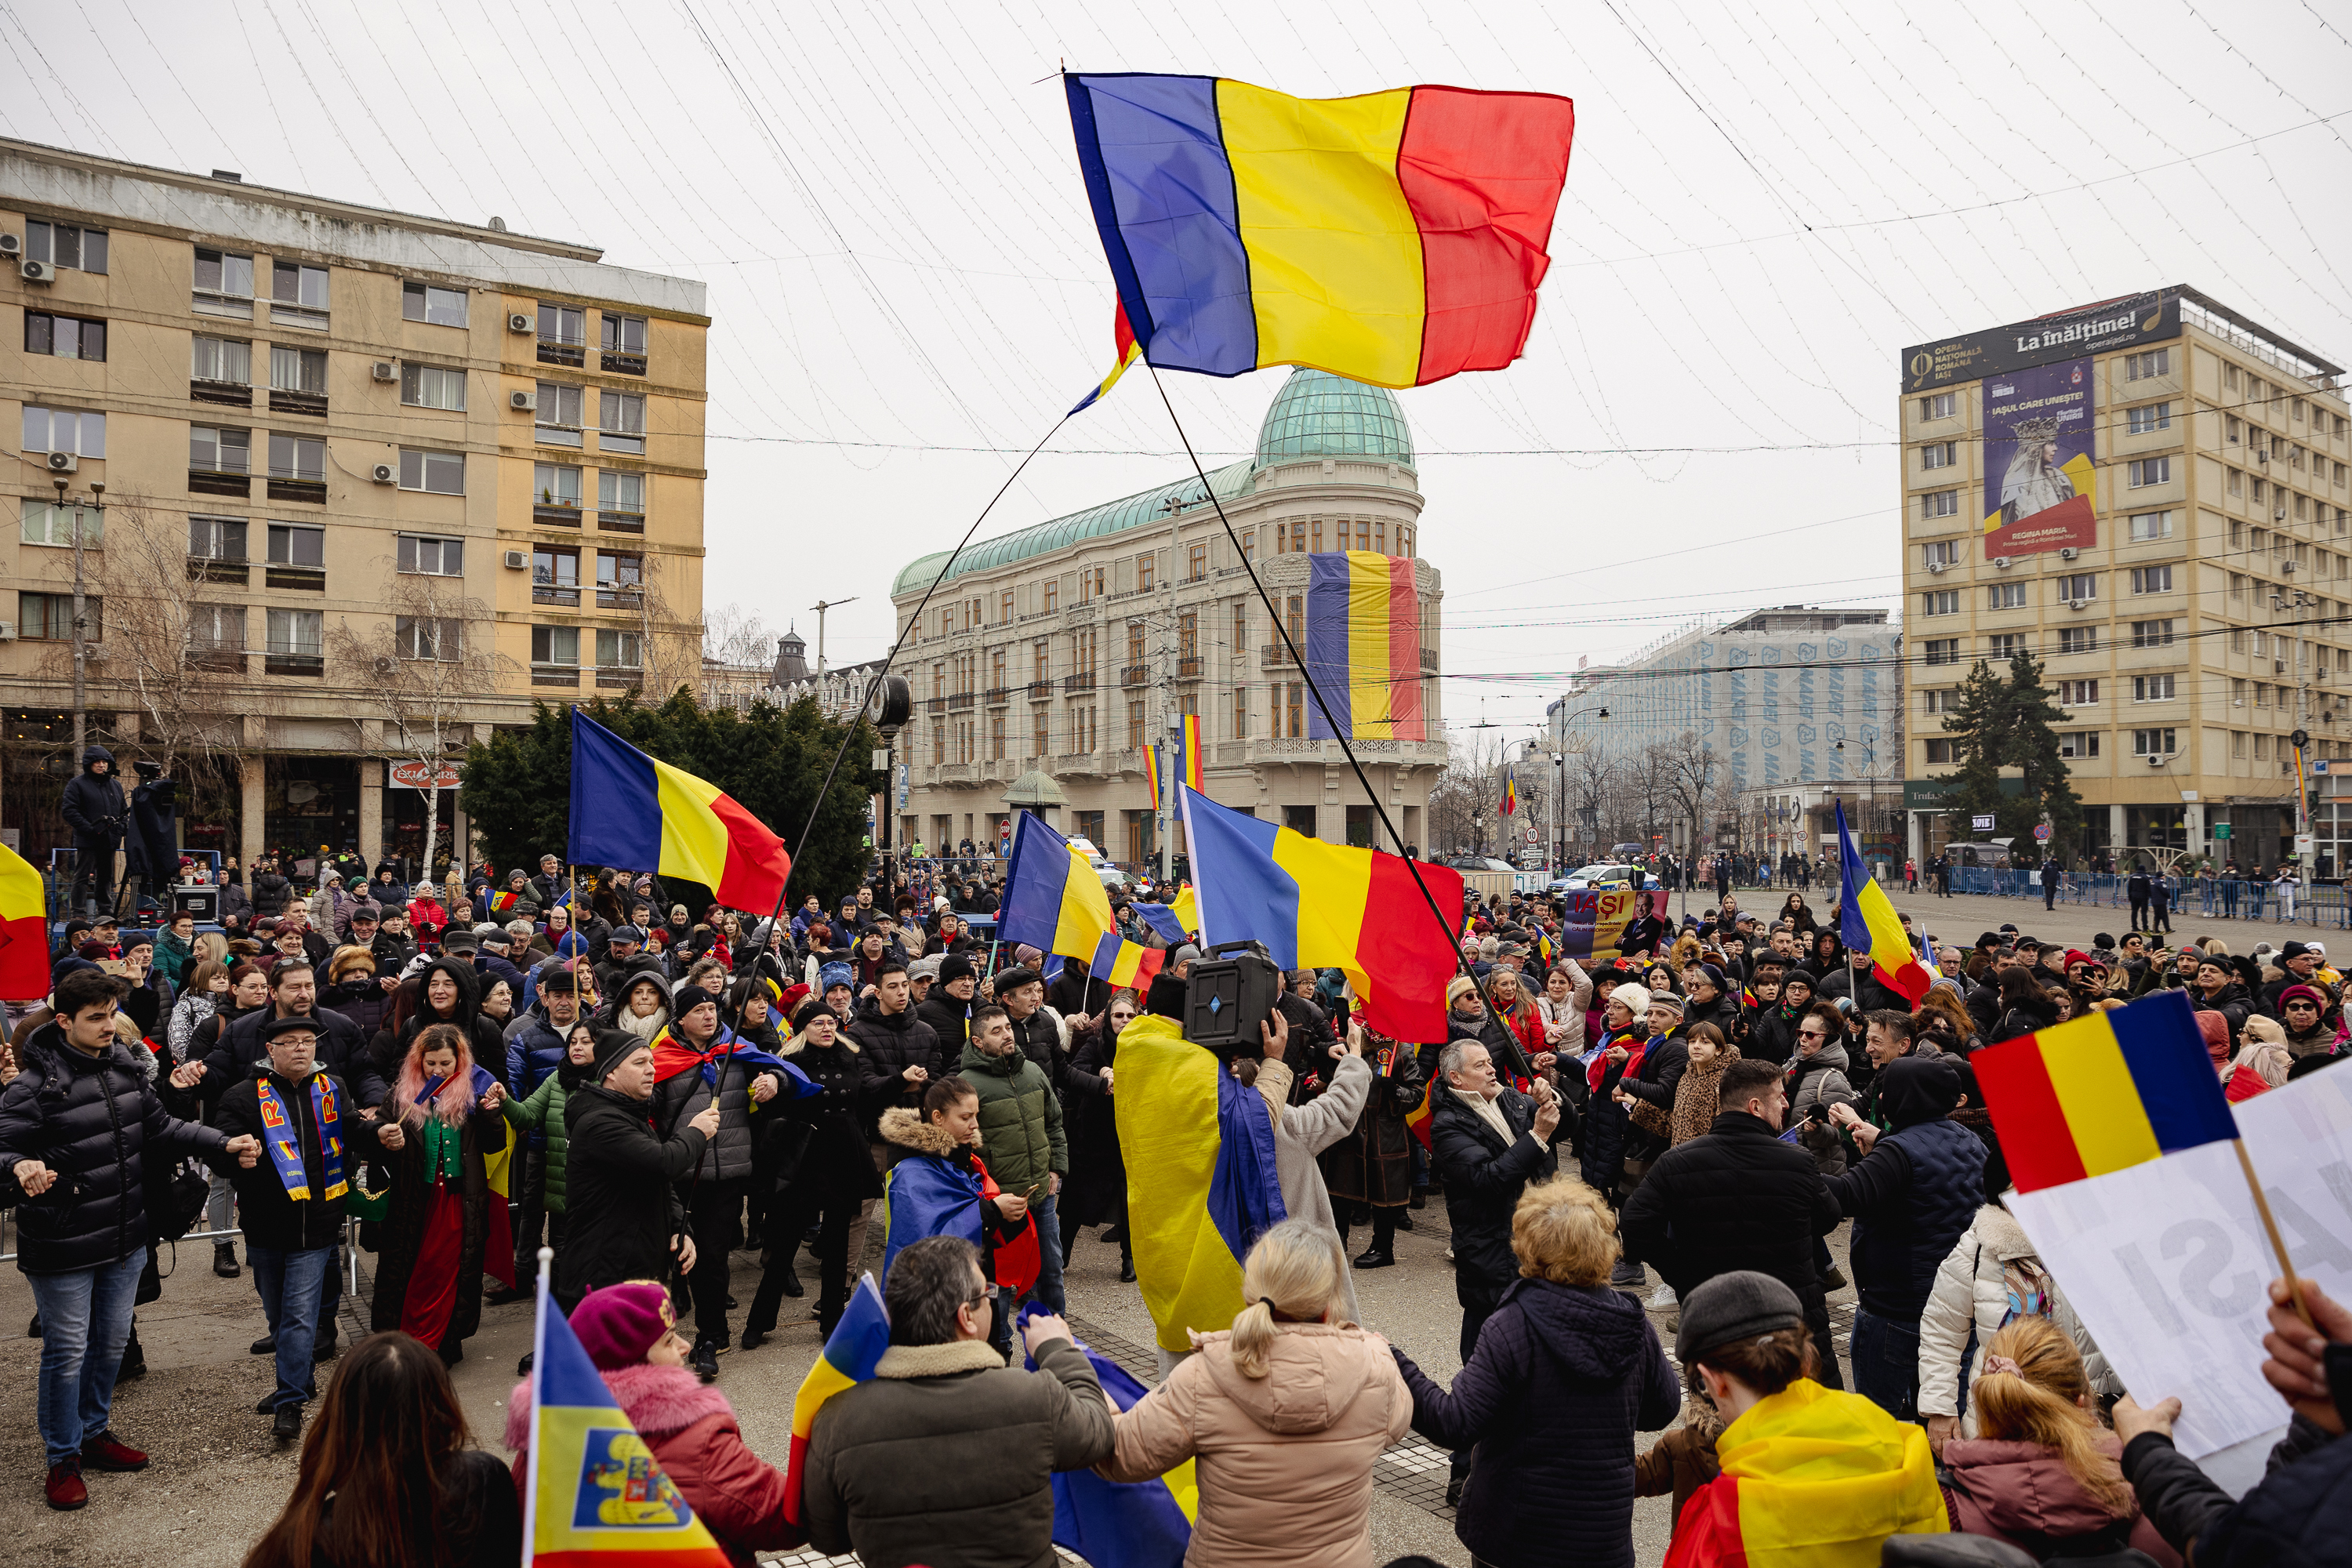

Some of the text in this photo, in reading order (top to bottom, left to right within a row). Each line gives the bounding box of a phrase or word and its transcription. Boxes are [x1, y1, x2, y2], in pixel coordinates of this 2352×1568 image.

[2017, 311, 2136, 352] La înălțime!
[2085, 333, 2136, 350] operaiasi.ro
[1934, 343, 1962, 355] OPERA
[1935, 370, 1951, 379] IAȘI
[1992, 391, 2084, 416] IAȘUL CARE UNEȘTE!
[2012, 527, 2067, 539] REGINA MARIA
[1762, 670, 1779, 724] MAPEI
[1799, 667, 1814, 720] MAPEI
[1528, 831, 1536, 840] 10
[1575, 894, 1624, 920] IAȘI
